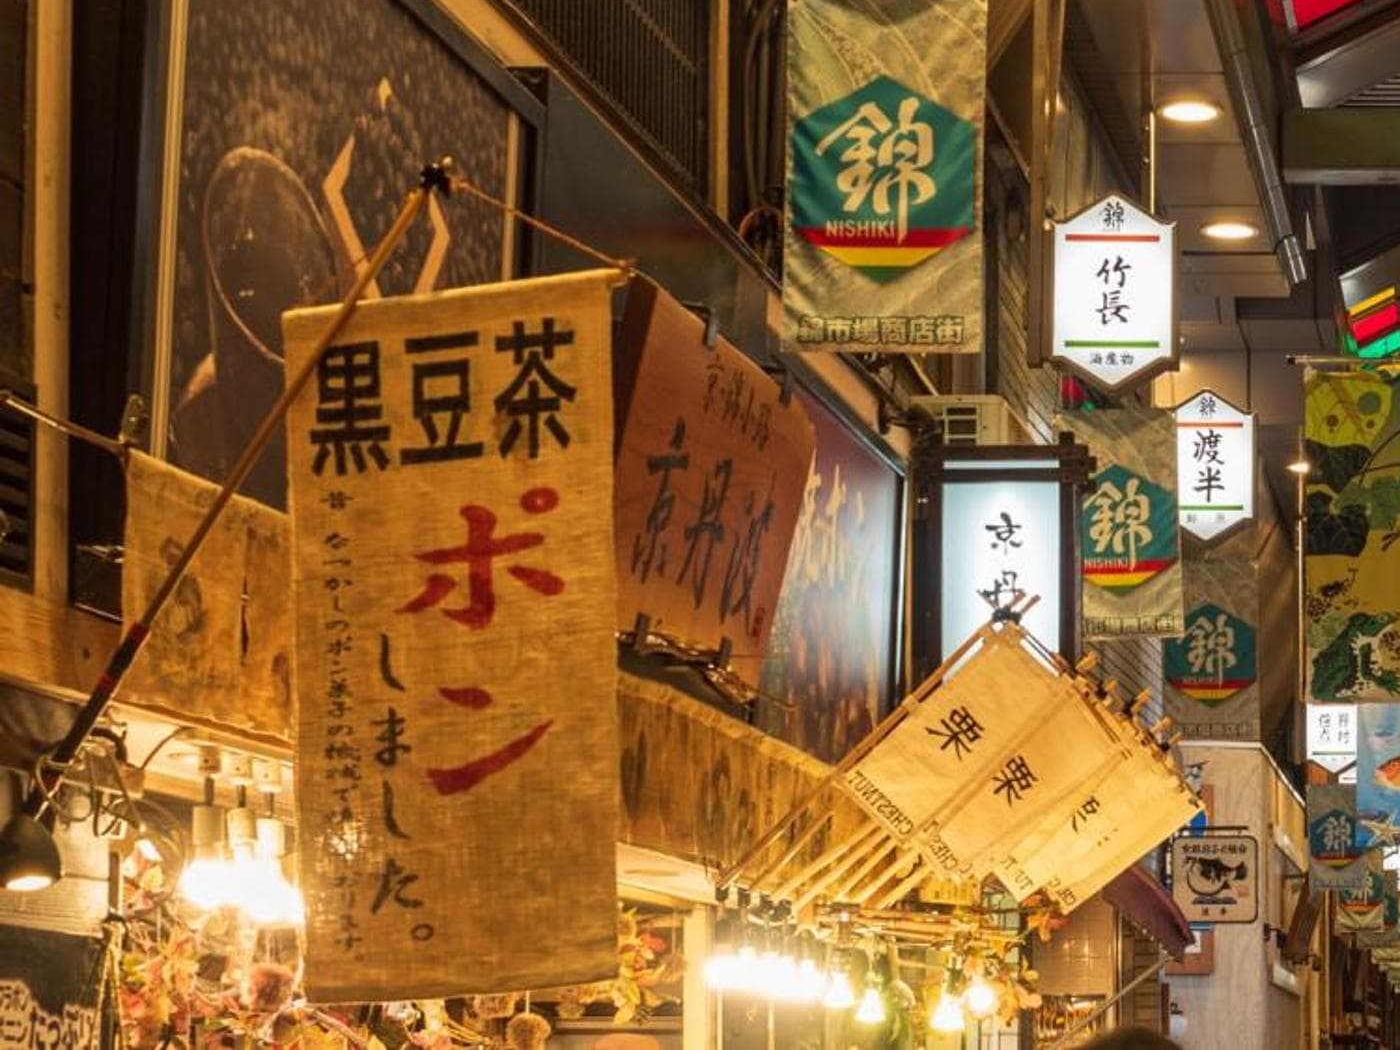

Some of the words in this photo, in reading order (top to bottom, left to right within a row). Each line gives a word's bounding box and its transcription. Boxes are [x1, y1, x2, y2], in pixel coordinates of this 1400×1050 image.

[814, 96, 938, 246] 錦
[825, 219, 896, 239] NISHIKI
[797, 315, 966, 345] 錦市場商店街
[1096, 255, 1131, 325] 竹長
[309, 316, 578, 477] 黒豆茶
[1193, 429, 1226, 503] 渡半
[632, 416, 778, 636] 京丹波
[1083, 478, 1154, 572] 錦
[394, 487, 567, 797] ポン
[1177, 614, 1237, 688] 錦
[370, 633, 436, 942] しました。
